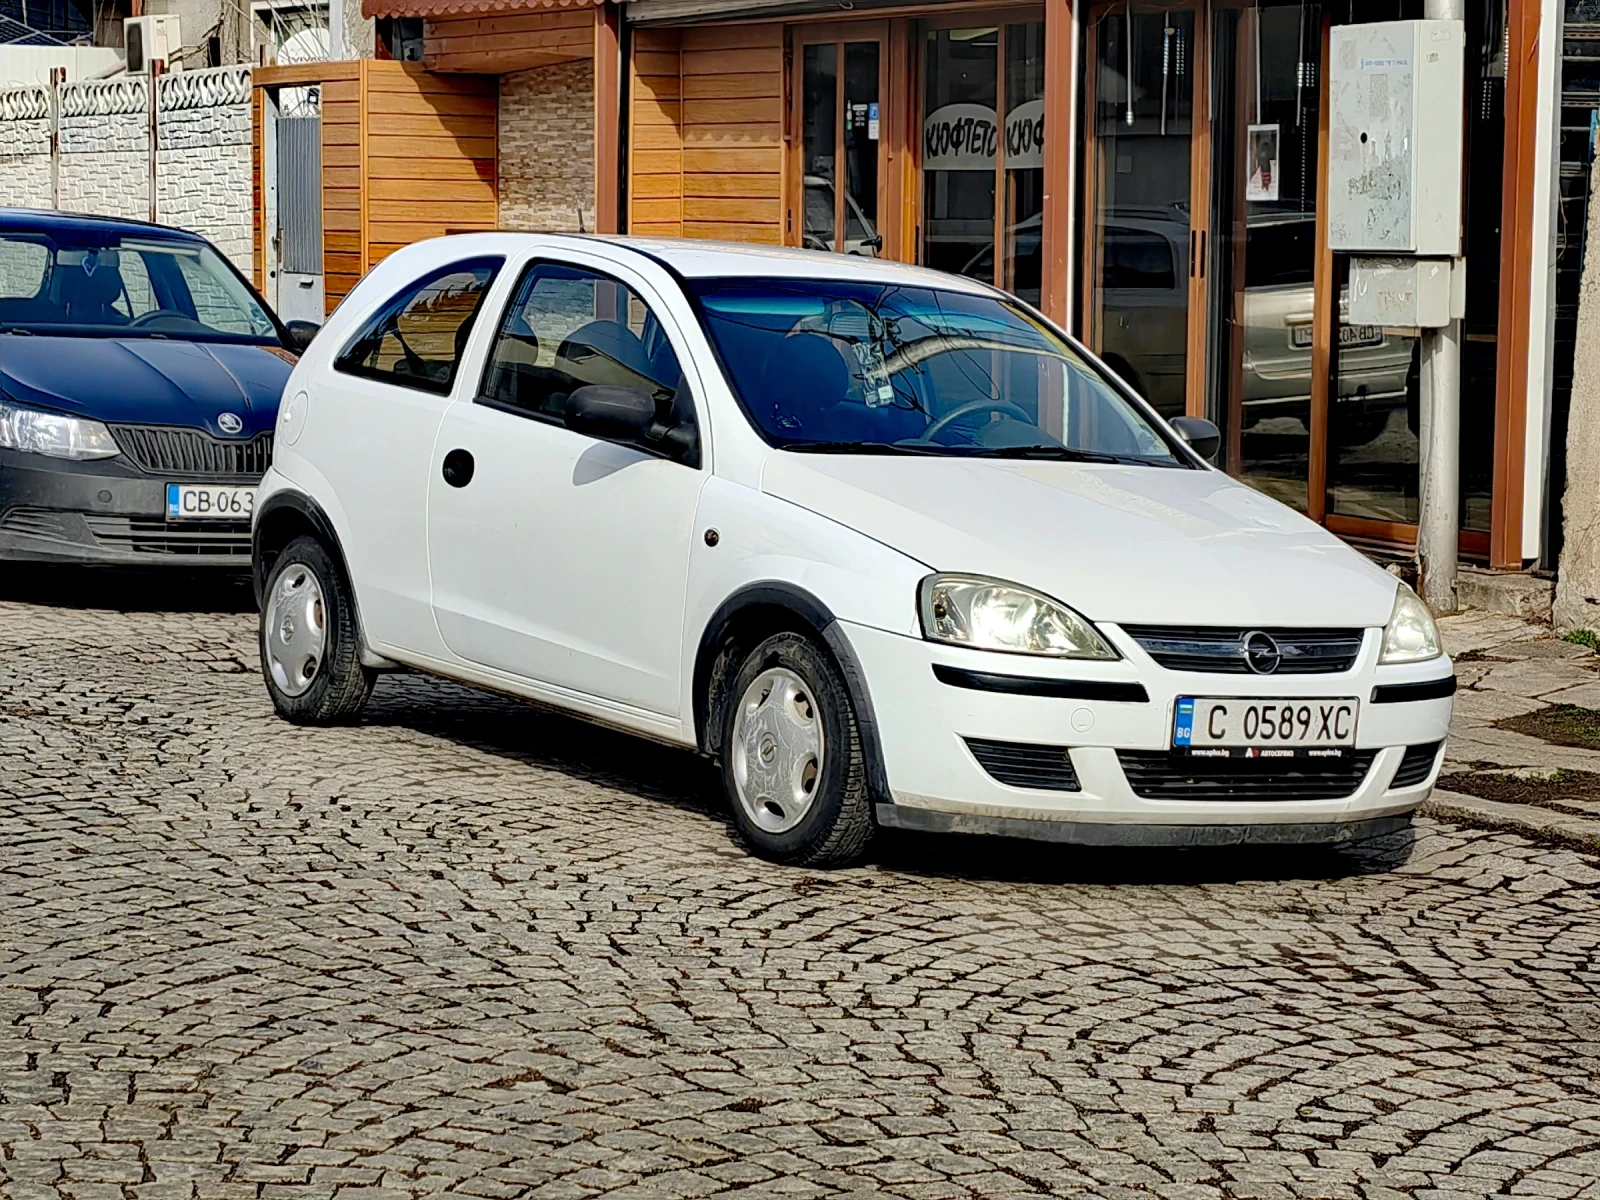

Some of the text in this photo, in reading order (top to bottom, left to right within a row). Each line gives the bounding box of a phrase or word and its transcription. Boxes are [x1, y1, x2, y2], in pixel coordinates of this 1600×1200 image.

[1176, 726, 1190, 738] BG
[1207, 705, 1351, 740] C 0589 XC
